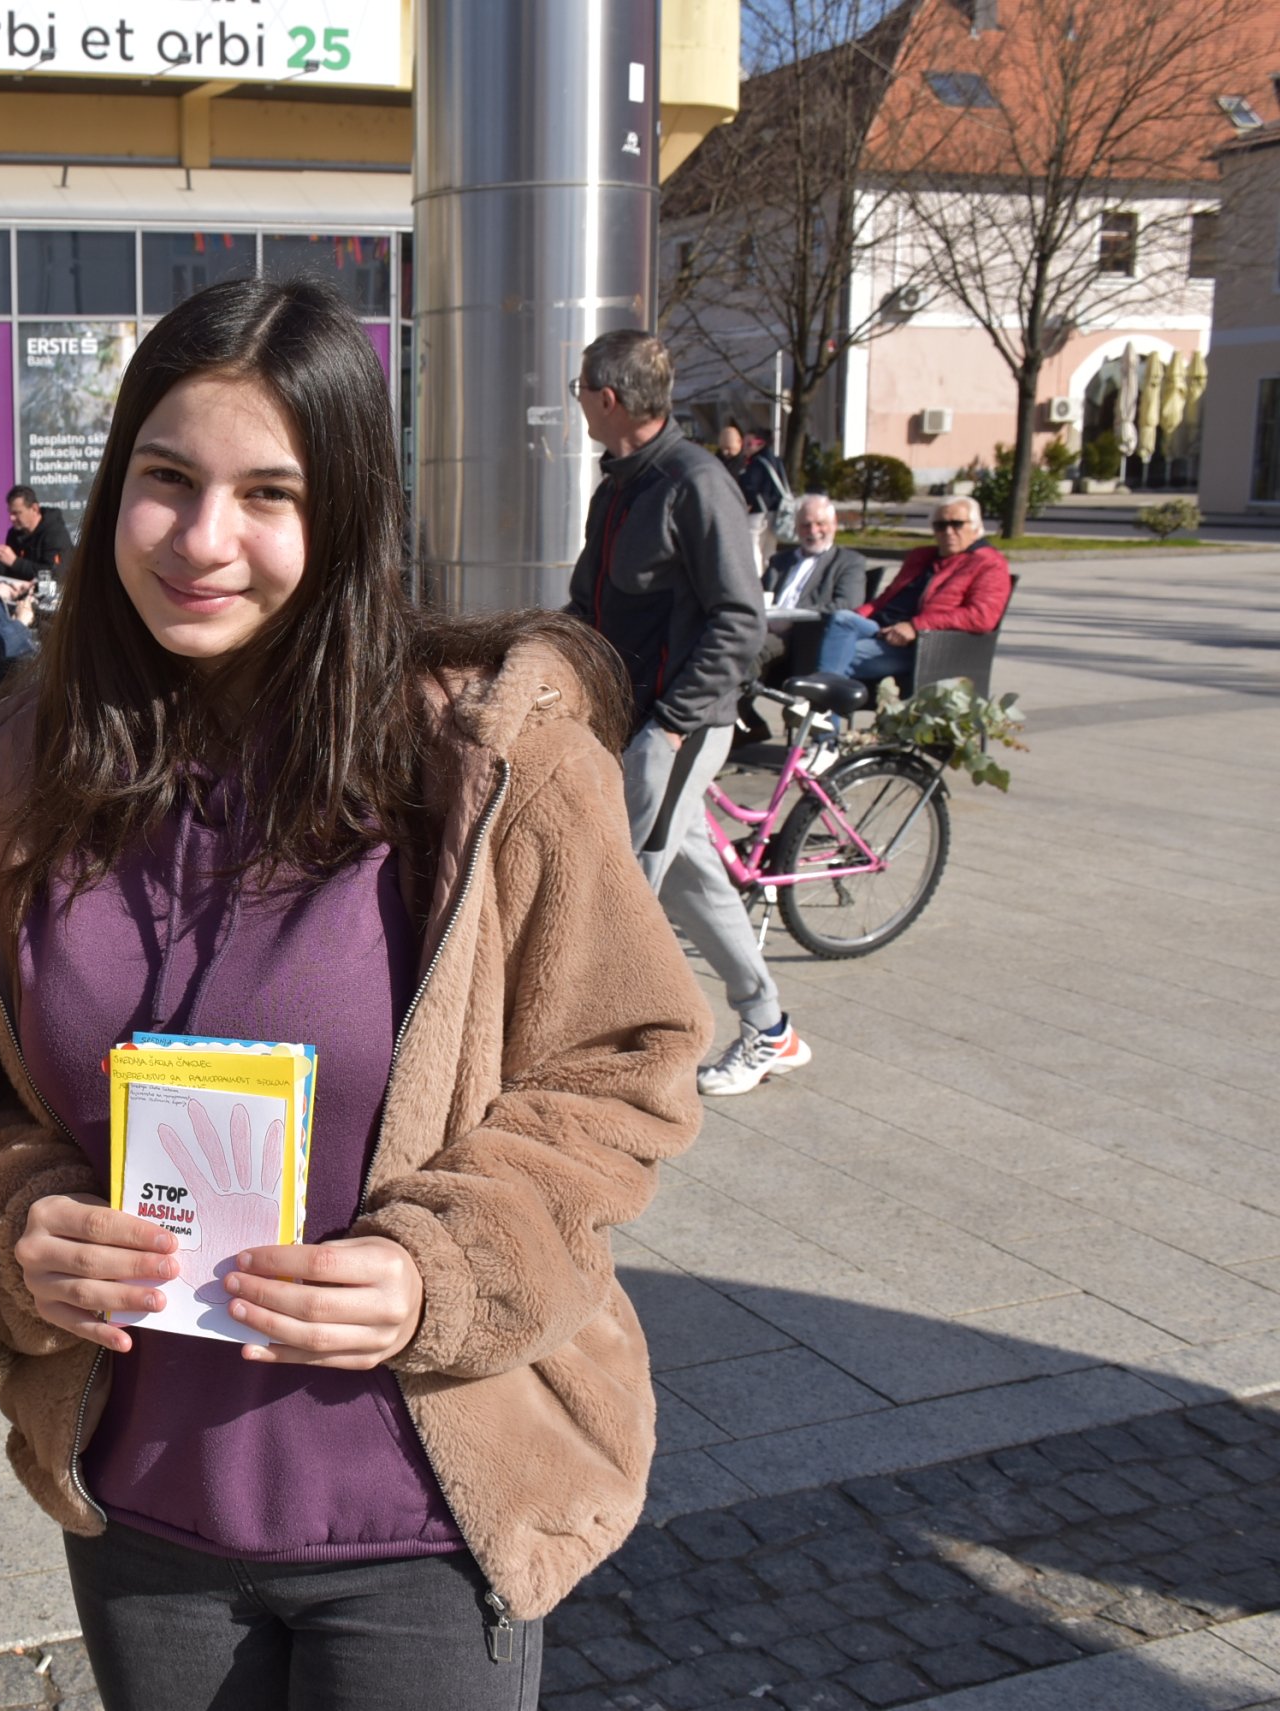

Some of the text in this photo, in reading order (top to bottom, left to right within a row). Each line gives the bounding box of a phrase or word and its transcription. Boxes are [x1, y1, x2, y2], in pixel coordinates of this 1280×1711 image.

[80, 19, 134, 62] et
[157, 21, 265, 67] orbi
[287, 25, 351, 70] 25
[27, 337, 79, 354] ERSTE
[27, 355, 53, 367] Bank
[29, 433, 86, 446] Besplatno
[29, 446, 83, 460] aplikaciju
[35, 459, 89, 472] bankarite
[29, 472, 82, 485] mobitela.
[140, 1182, 188, 1204] STOP
[137, 1201, 195, 1223] NASILJU
